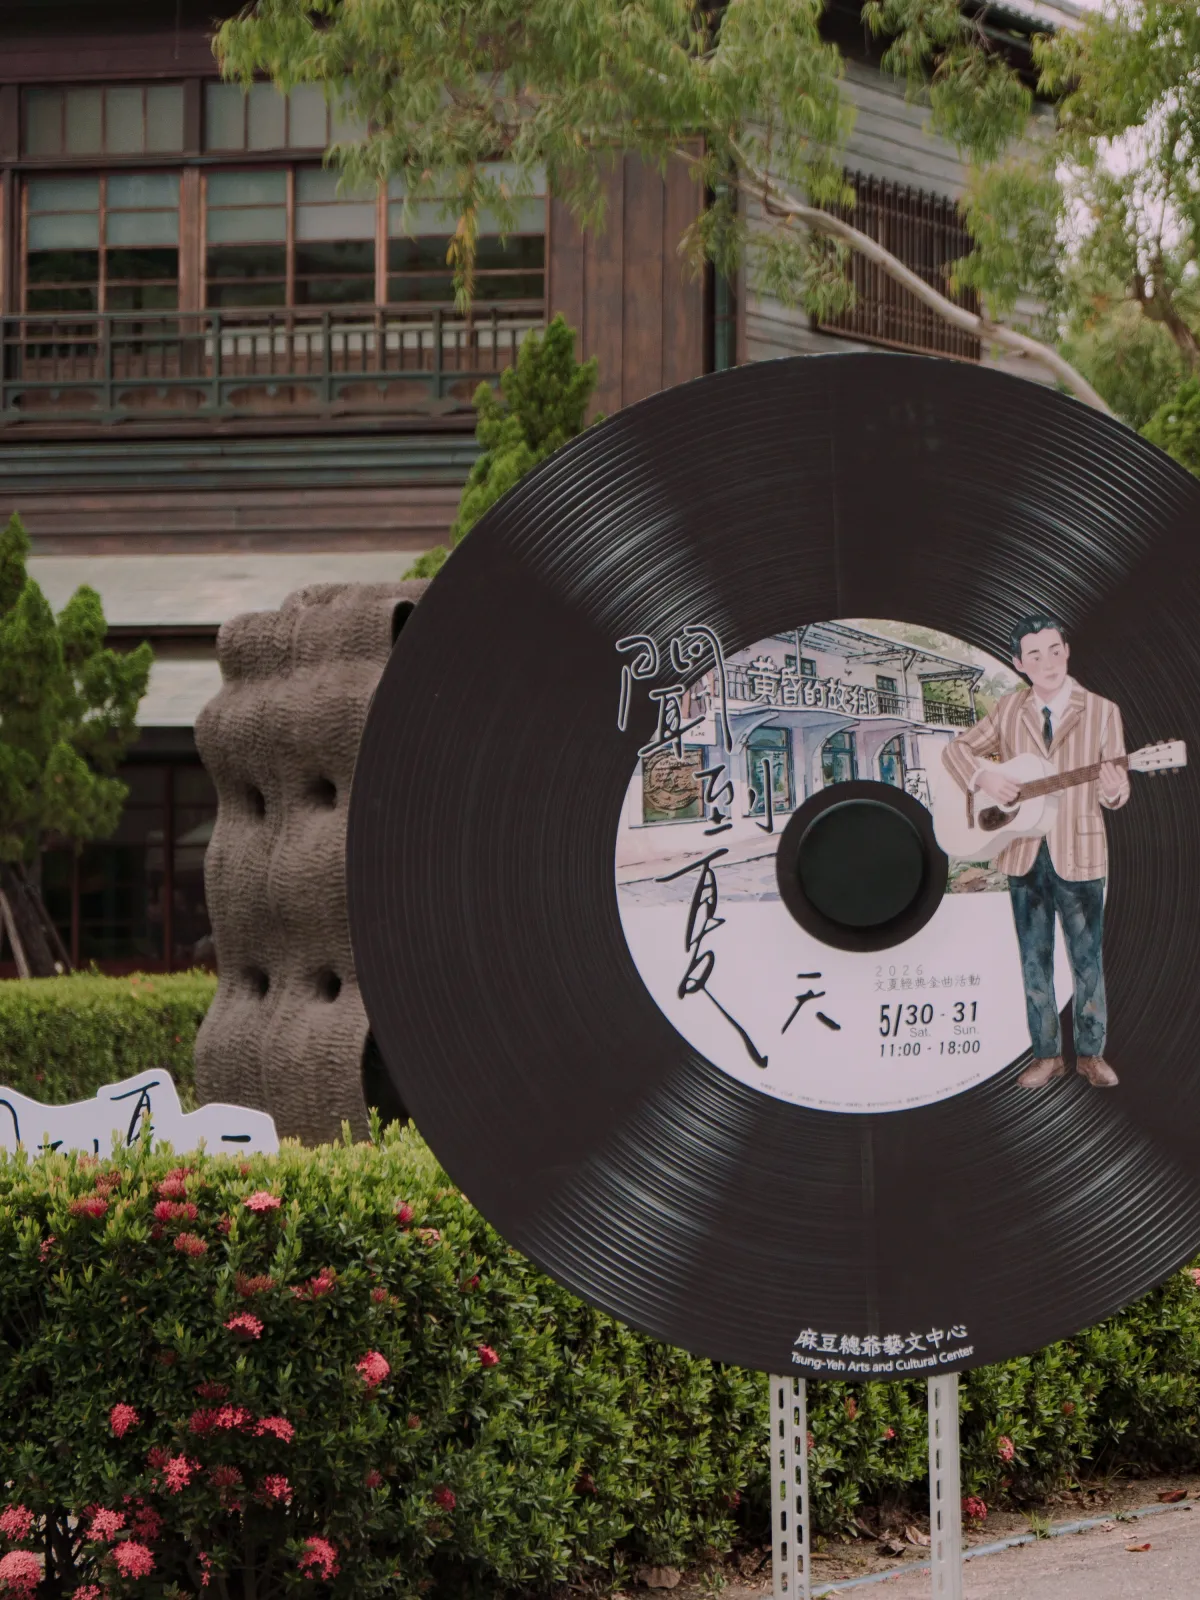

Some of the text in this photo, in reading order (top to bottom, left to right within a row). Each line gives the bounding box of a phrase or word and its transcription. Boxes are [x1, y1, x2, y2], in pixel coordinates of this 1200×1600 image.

[874, 964, 924, 977] 2026
[873, 974, 981, 991] 文夏經典金曲活動
[879, 1003, 934, 1037] 5/30
[952, 1000, 978, 1023] 31
[909, 1024, 980, 1038] Sat. Sun.
[880, 1042, 921, 1057] 11:00
[939, 1040, 981, 1055] 18:00
[794, 1324, 968, 1357] 麻豆總爺藝文中心
[791, 1345, 975, 1373] Tsung-Yeh Arts and Cultural Center
